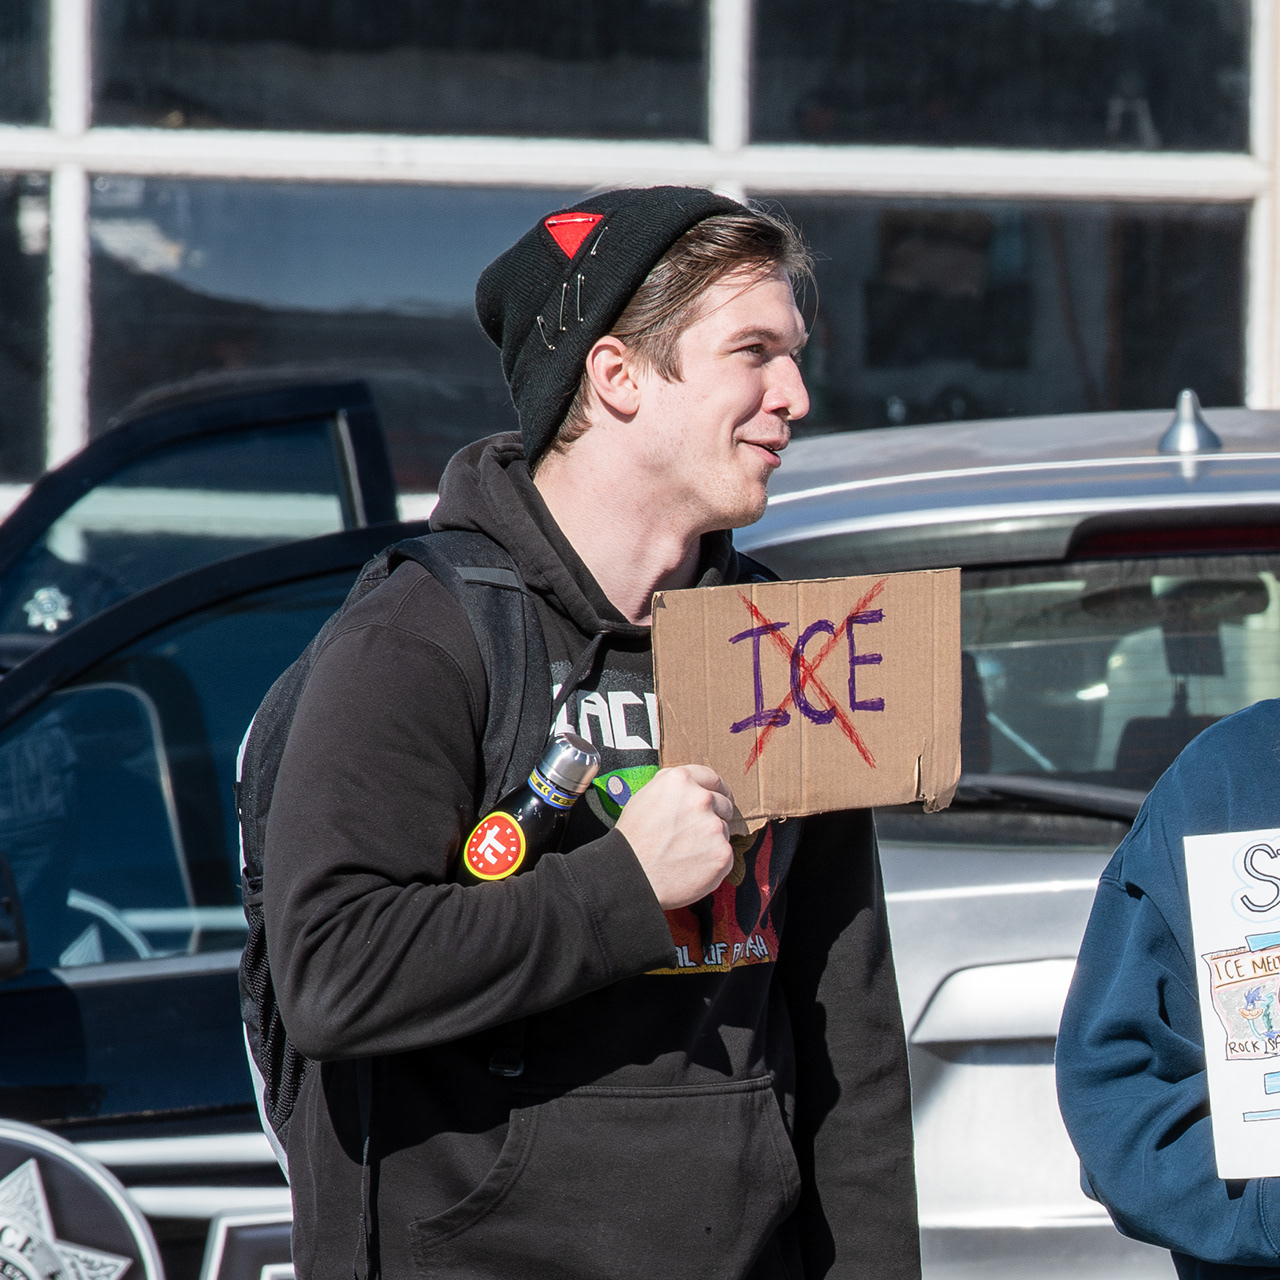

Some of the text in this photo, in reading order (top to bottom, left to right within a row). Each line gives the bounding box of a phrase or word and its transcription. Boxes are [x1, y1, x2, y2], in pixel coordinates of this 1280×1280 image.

[728, 608, 885, 735] ICE
[1213, 959, 1245, 981] ICE
[1228, 1039, 1261, 1055] ROCK
